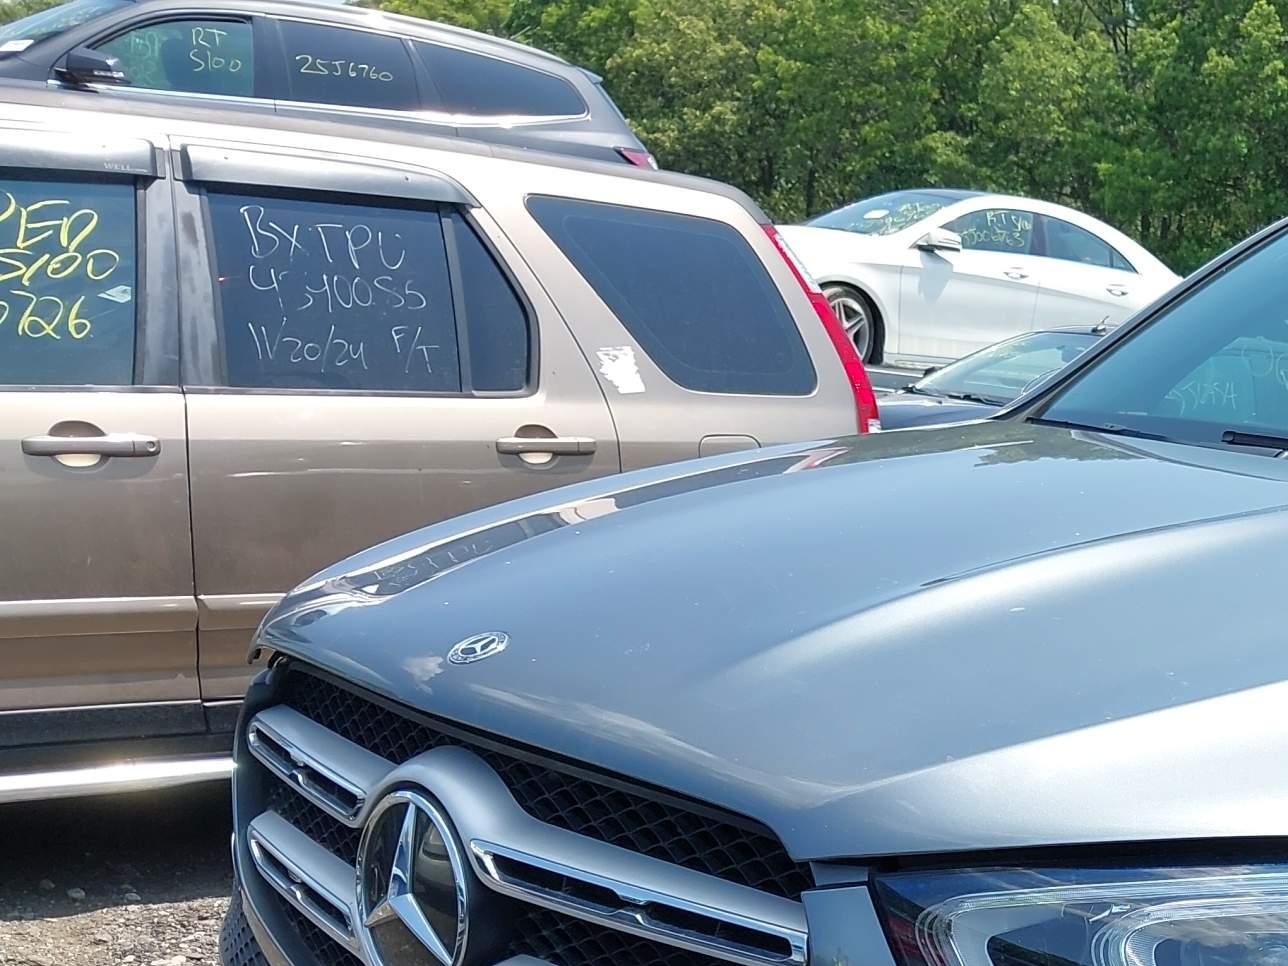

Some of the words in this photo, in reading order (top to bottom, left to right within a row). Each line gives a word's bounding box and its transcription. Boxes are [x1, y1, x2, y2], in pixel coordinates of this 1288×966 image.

[192, 28, 228, 49] RT
[190, 50, 242, 73] S100
[296, 55, 393, 81] 25J6760
